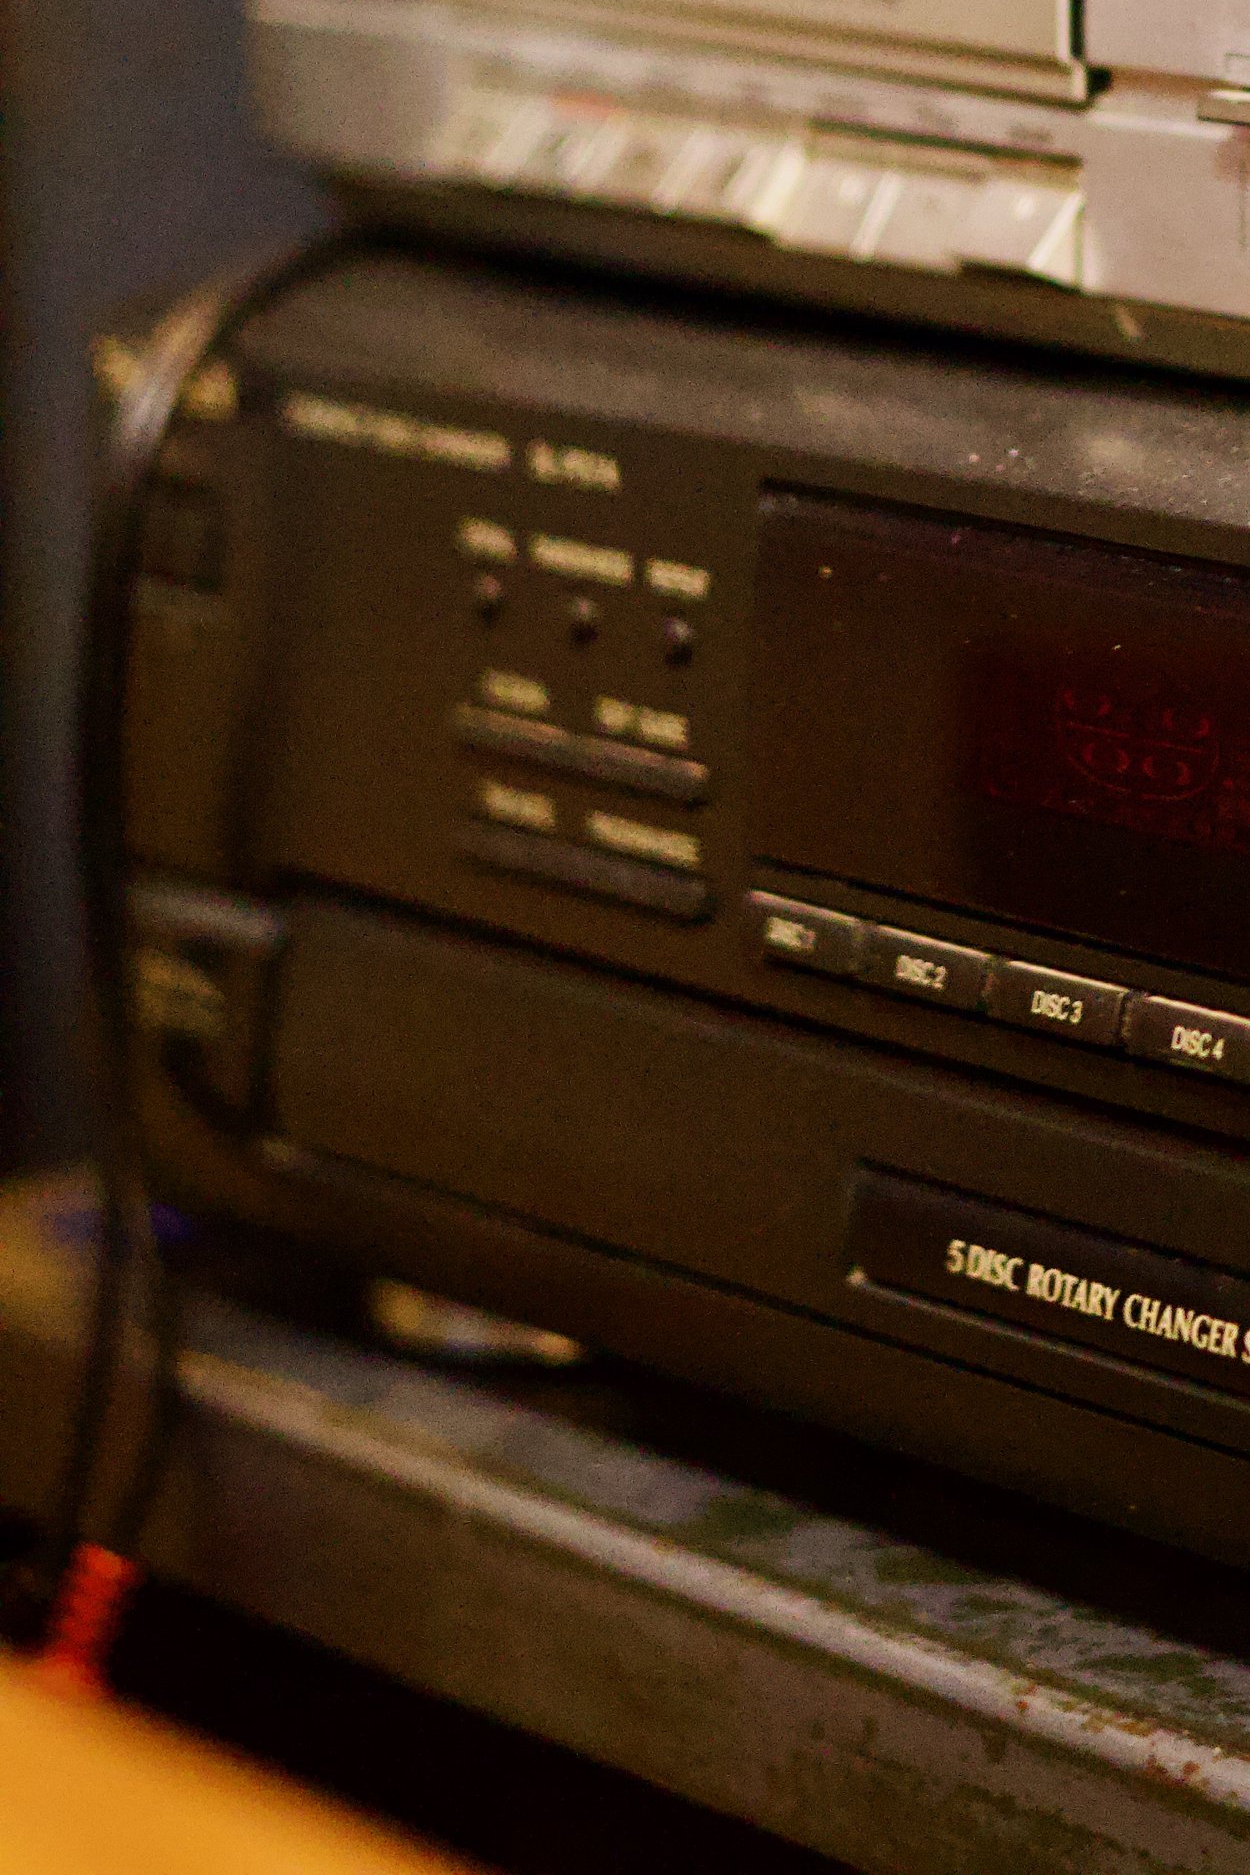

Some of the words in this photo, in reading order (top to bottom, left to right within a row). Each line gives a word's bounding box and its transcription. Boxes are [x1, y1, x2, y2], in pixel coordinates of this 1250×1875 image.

[895, 954, 933, 986] DISC
[931, 965, 947, 991] 2
[1030, 990, 1070, 1021] DISC
[1070, 999, 1084, 1025] 3
[1170, 1025, 1212, 1059] DISC
[1210, 1036, 1225, 1062] 4
[946, 1239, 967, 1276] 5
[965, 1244, 1025, 1292] DISC
[1025, 1262, 1121, 1322] ROTARY
[1122, 1293, 1240, 1360] CHANGER
